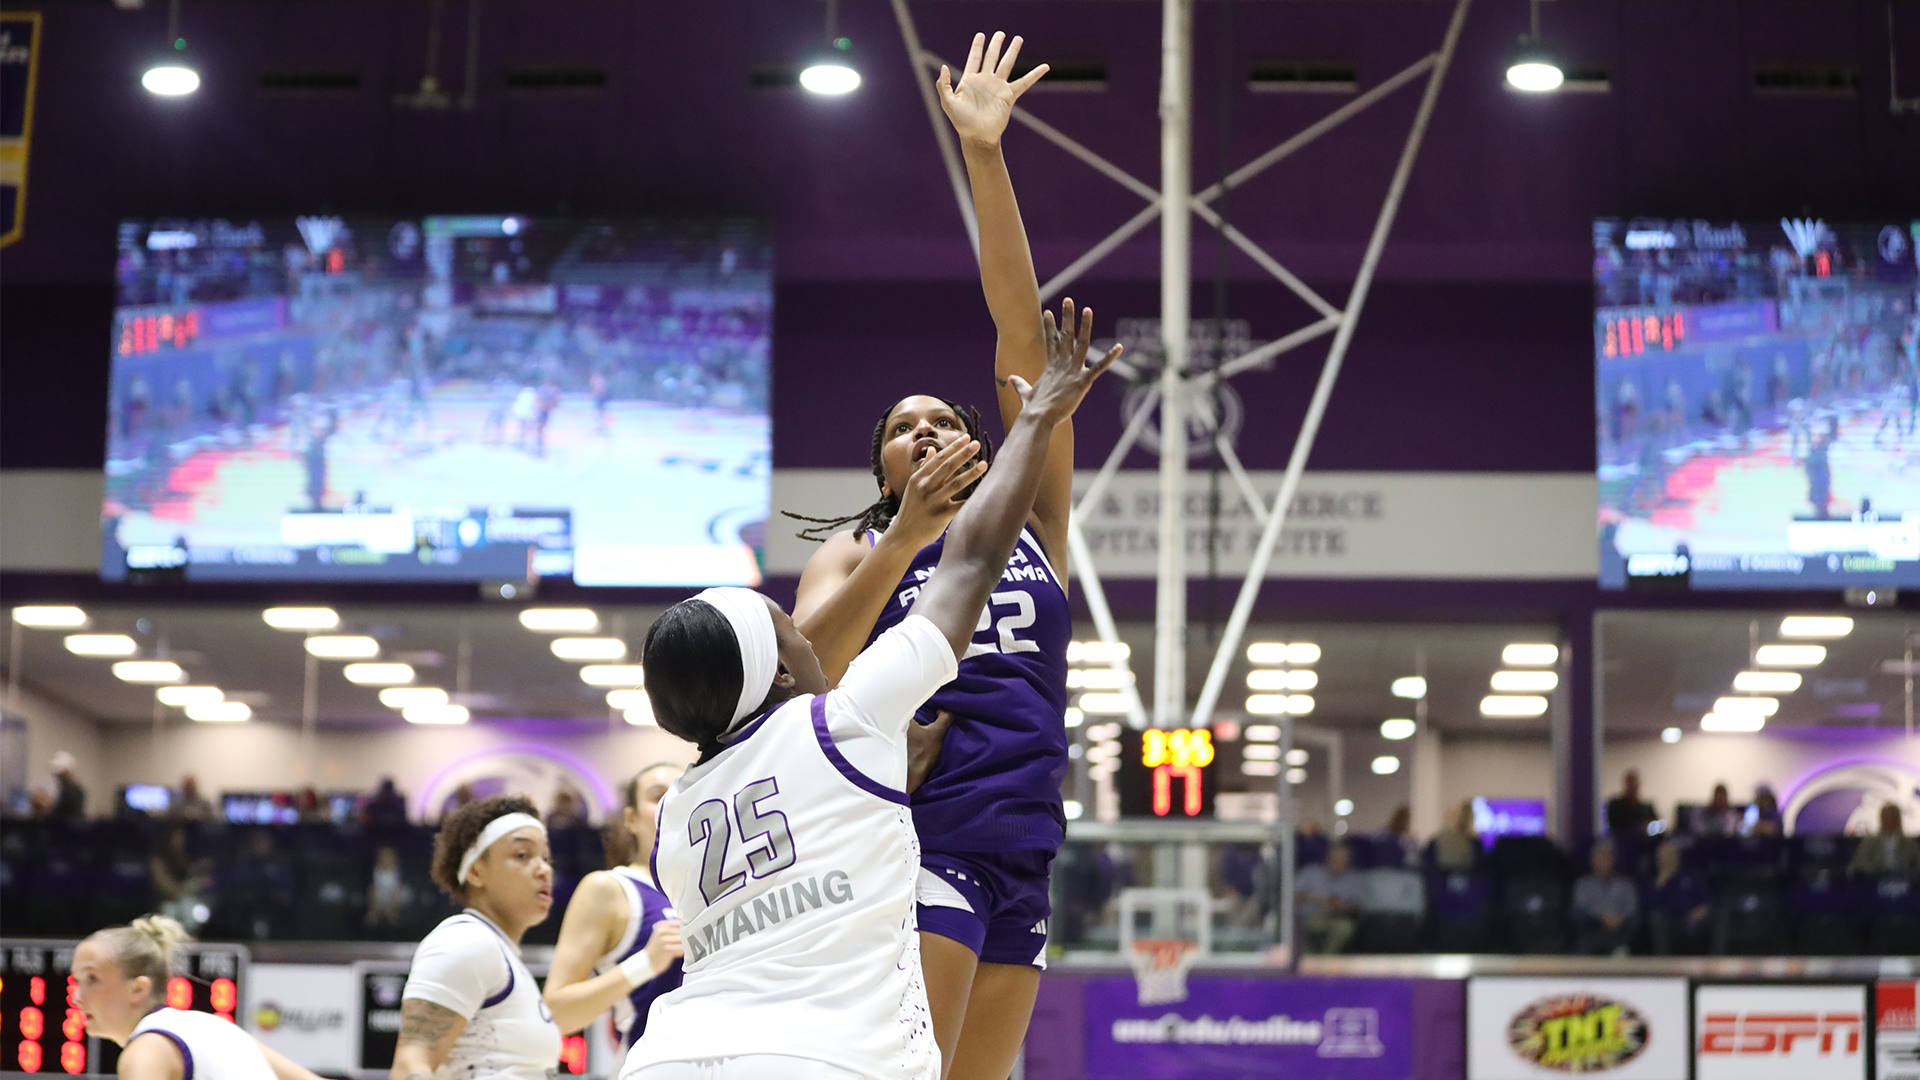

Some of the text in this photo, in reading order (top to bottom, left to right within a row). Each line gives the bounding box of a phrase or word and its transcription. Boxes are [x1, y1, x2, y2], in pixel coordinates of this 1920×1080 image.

[687, 776, 797, 908] 25
[686, 869, 854, 963] AMANING
[1701, 1012, 1861, 1055] ESPN
